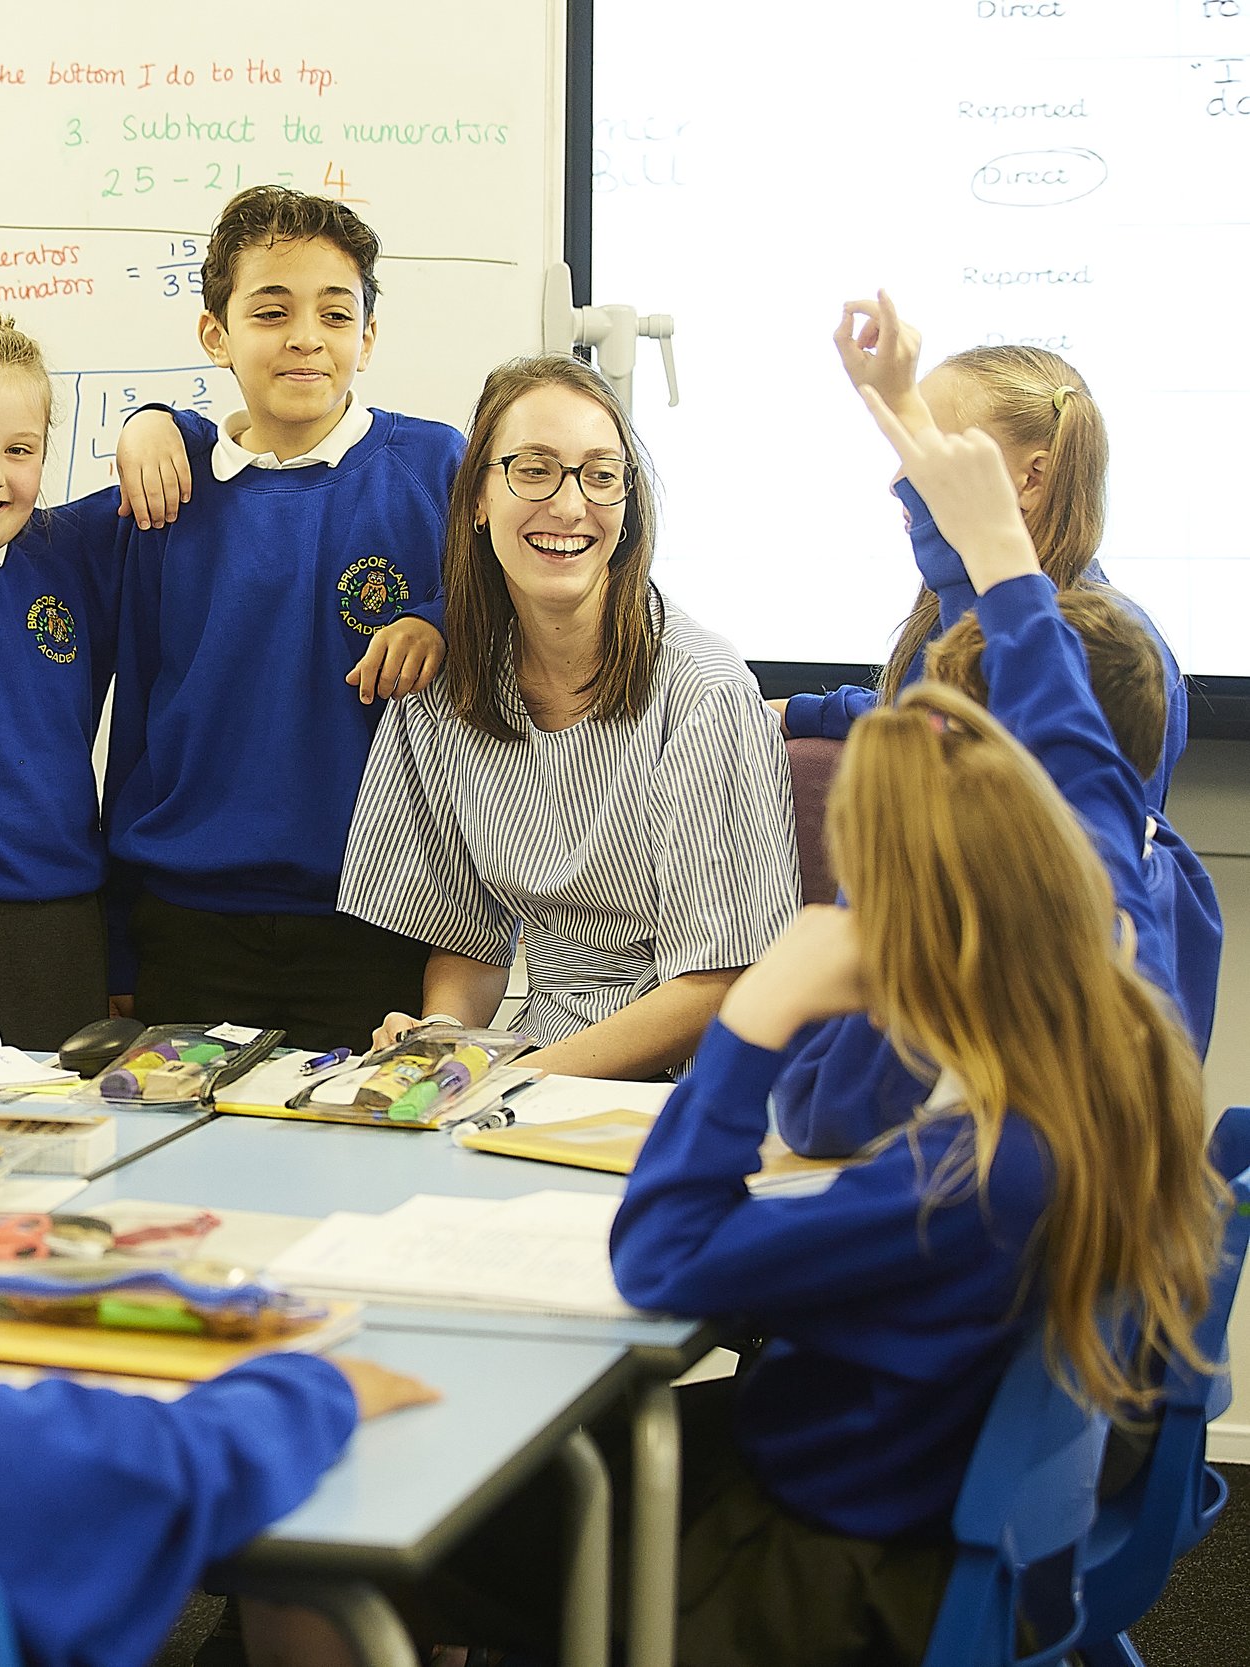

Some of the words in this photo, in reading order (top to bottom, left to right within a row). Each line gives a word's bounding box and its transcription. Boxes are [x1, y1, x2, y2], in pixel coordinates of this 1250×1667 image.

[48, 62, 126, 87] bottom
[137, 63, 157, 89] I
[166, 63, 196, 87] do
[212, 62, 234, 84] to
[246, 58, 283, 85] the
[958, 98, 1089, 125] Reported
[122, 112, 257, 144] Subtract
[284, 115, 324, 145] the
[101, 165, 156, 198] 25
[204, 162, 243, 191] 21
[981, 165, 1070, 185] Direct
[170, 239, 198, 257] 15
[962, 264, 1094, 291] Reported
[337, 556, 388, 592] BRISCOE
[388, 564, 409, 600] LANE
[27, 595, 56, 630] BRISCOE
